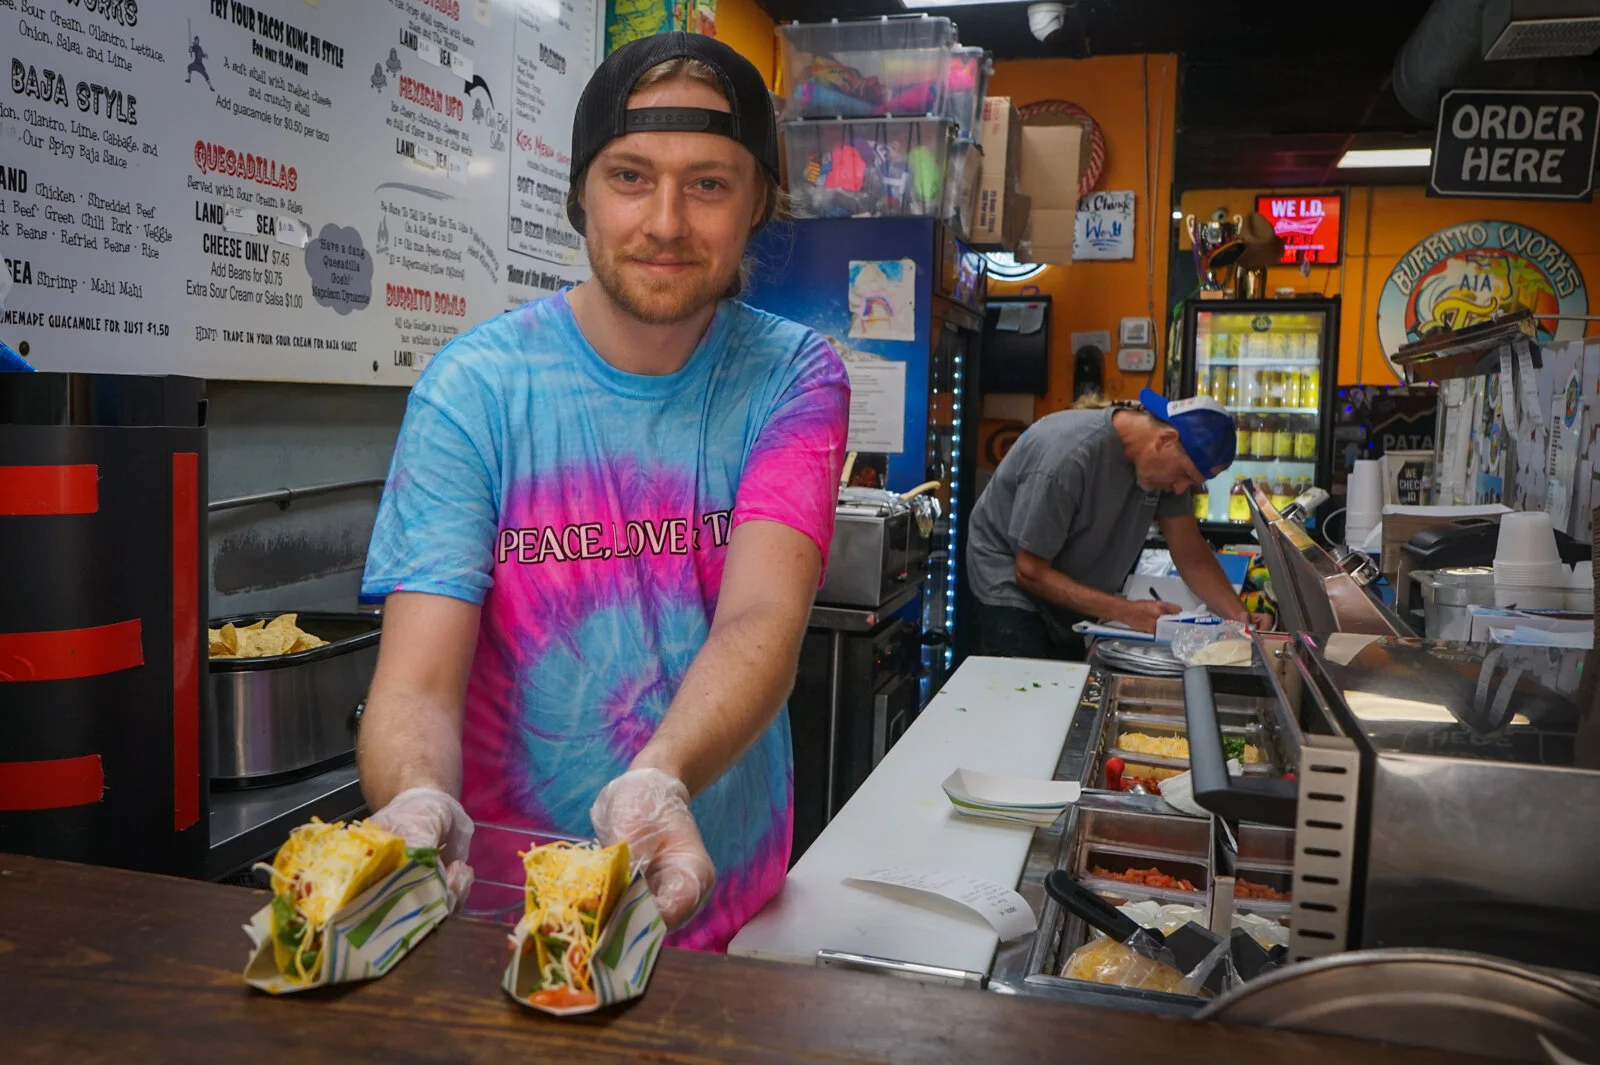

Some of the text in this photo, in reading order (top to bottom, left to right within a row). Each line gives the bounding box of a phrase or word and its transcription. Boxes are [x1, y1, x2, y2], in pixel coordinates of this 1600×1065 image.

[66, 0, 138, 27] ORKS
[210, 0, 344, 69] TRY YOUR TACOS KUNG FU STYLE
[400, 28, 418, 51] LAND
[87, 47, 104, 63] and
[108, 51, 133, 72] Lime
[12, 57, 138, 125] BAJA STYLE
[216, 94, 329, 142] Add guacamole for $0.50 per taco
[1452, 104, 1585, 141] ORDER
[23, 129, 128, 169] Our Spicy Baja Sauce
[142, 143, 158, 157] and
[396, 137, 415, 159] LAND
[195, 139, 298, 192] QUESADILLAS
[1461, 146, 1566, 183] HERE
[0, 165, 157, 219] AND Chicken Shredded Beef
[188, 175, 213, 195] Served
[215, 182, 234, 199] with
[236, 187, 253, 203] Sour
[256, 191, 278, 206] Cream
[196, 201, 223, 225] LAND
[257, 214, 275, 236] SEA
[1271, 199, 1326, 217] WE I.D.
[45, 205, 75, 225] Green
[81, 213, 105, 231] Chili
[111, 216, 133, 235] Pork
[143, 224, 173, 244] Veggie
[16, 222, 48, 241] Beans
[60, 229, 98, 250] Refried
[103, 237, 131, 253] Beans
[141, 243, 160, 259] Rice
[203, 233, 290, 267] CHEESE ONLY $7.45
[211, 261, 283, 287] Add Beans for $0.75
[323, 255, 361, 273] Quesadilla
[1391, 223, 1581, 299] BURRITO WORKS
[37, 271, 78, 293] Shrimp
[90, 277, 116, 296] Mahi
[119, 281, 143, 299] Mahi
[186, 279, 303, 309] Extra Sour Cream or Salsa $1.00
[1, 309, 170, 337] MEMADE GUACAMOLE FOR JUST $1.50
[223, 329, 244, 344] TRADE
[247, 330, 255, 344] IN
[256, 332, 274, 346] YOUR
[275, 334, 291, 347] SOUR
[293, 336, 312, 349] CREAM
[314, 338, 324, 349] FOR
[394, 350, 412, 367] LAND
[1399, 479, 1420, 491] CHEC
